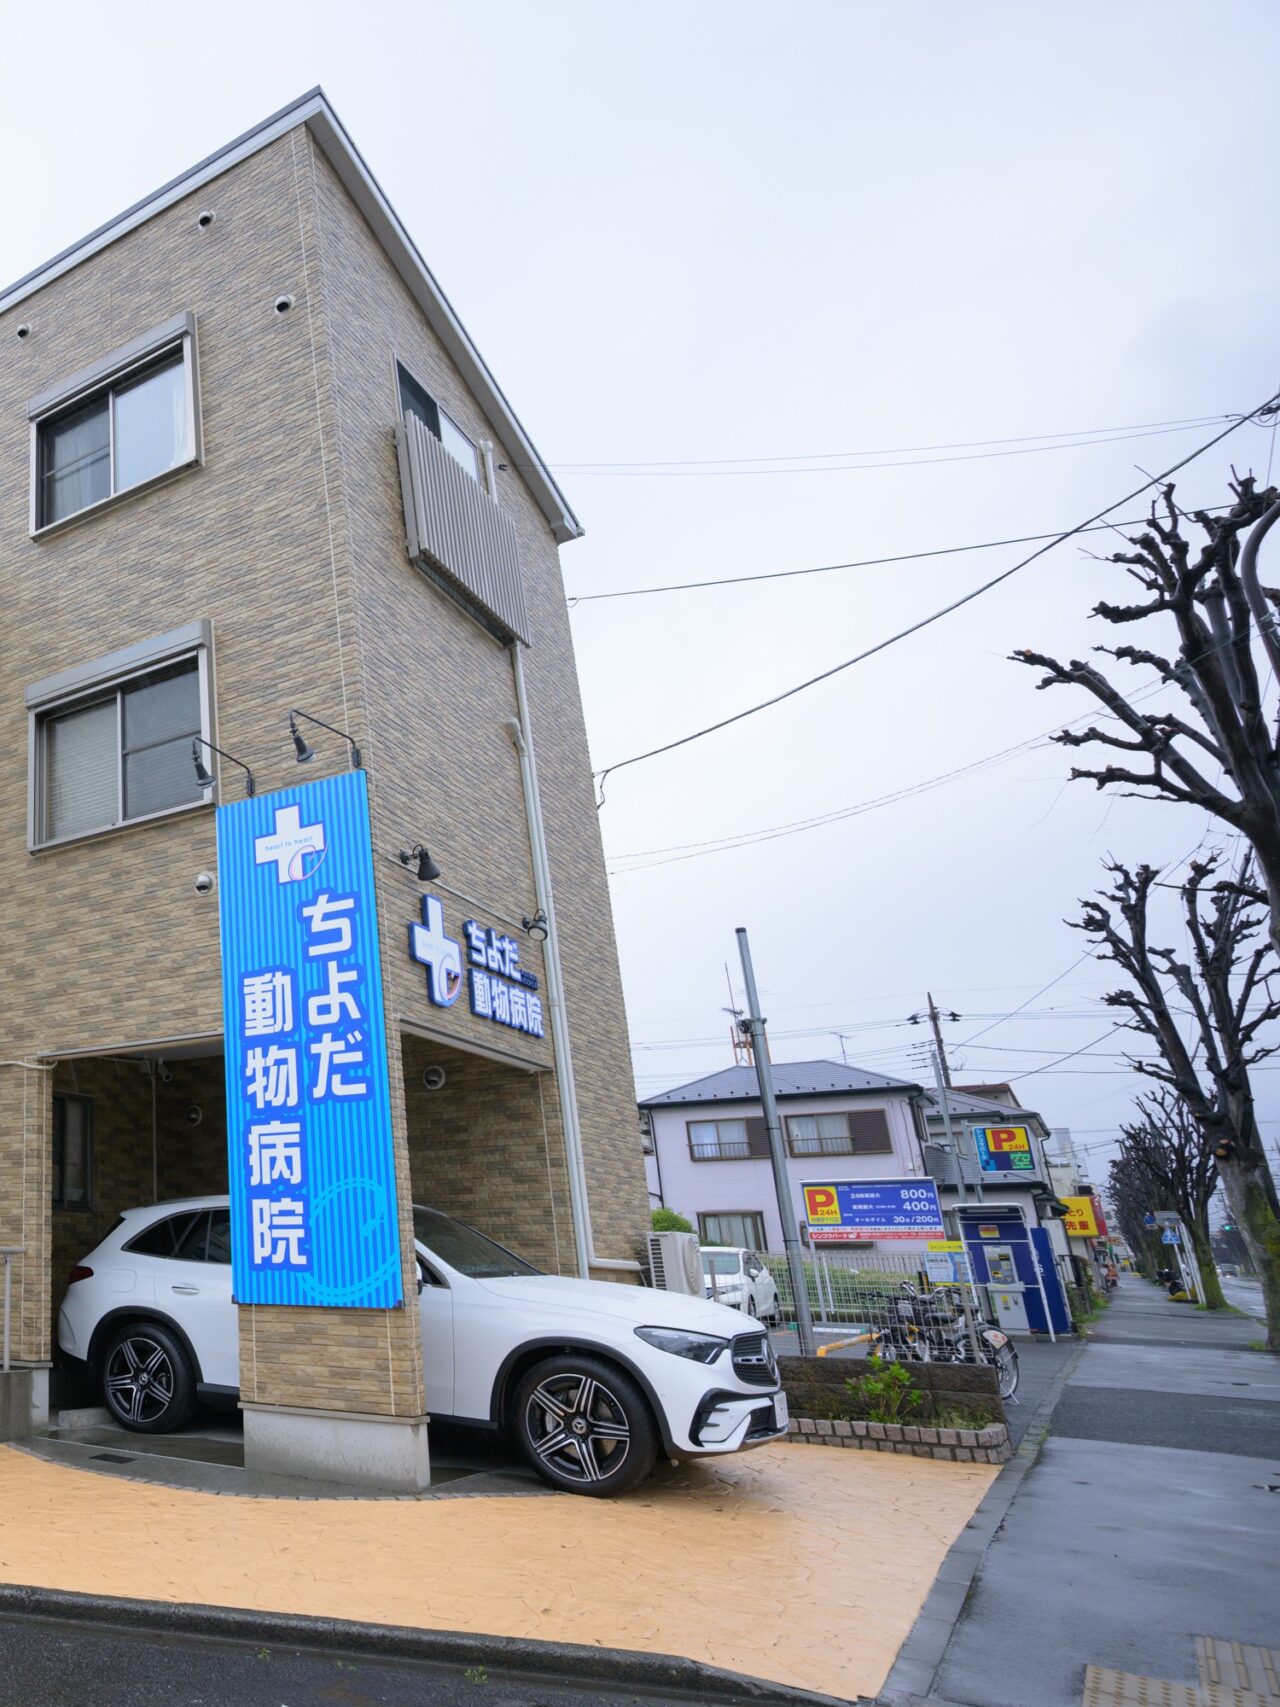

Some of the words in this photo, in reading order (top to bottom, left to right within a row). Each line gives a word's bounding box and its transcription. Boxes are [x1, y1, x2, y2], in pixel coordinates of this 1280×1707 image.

[465, 919, 522, 982] ちよだ
[303, 894, 367, 1099] ちよだ
[470, 969, 545, 1039] 動物病院
[243, 972, 308, 1266] 動物病院
[991, 1129, 1017, 1151] P
[806, 1189, 835, 1217] P
[900, 1188, 934, 1200] 800円
[902, 1201, 937, 1212] 400円
